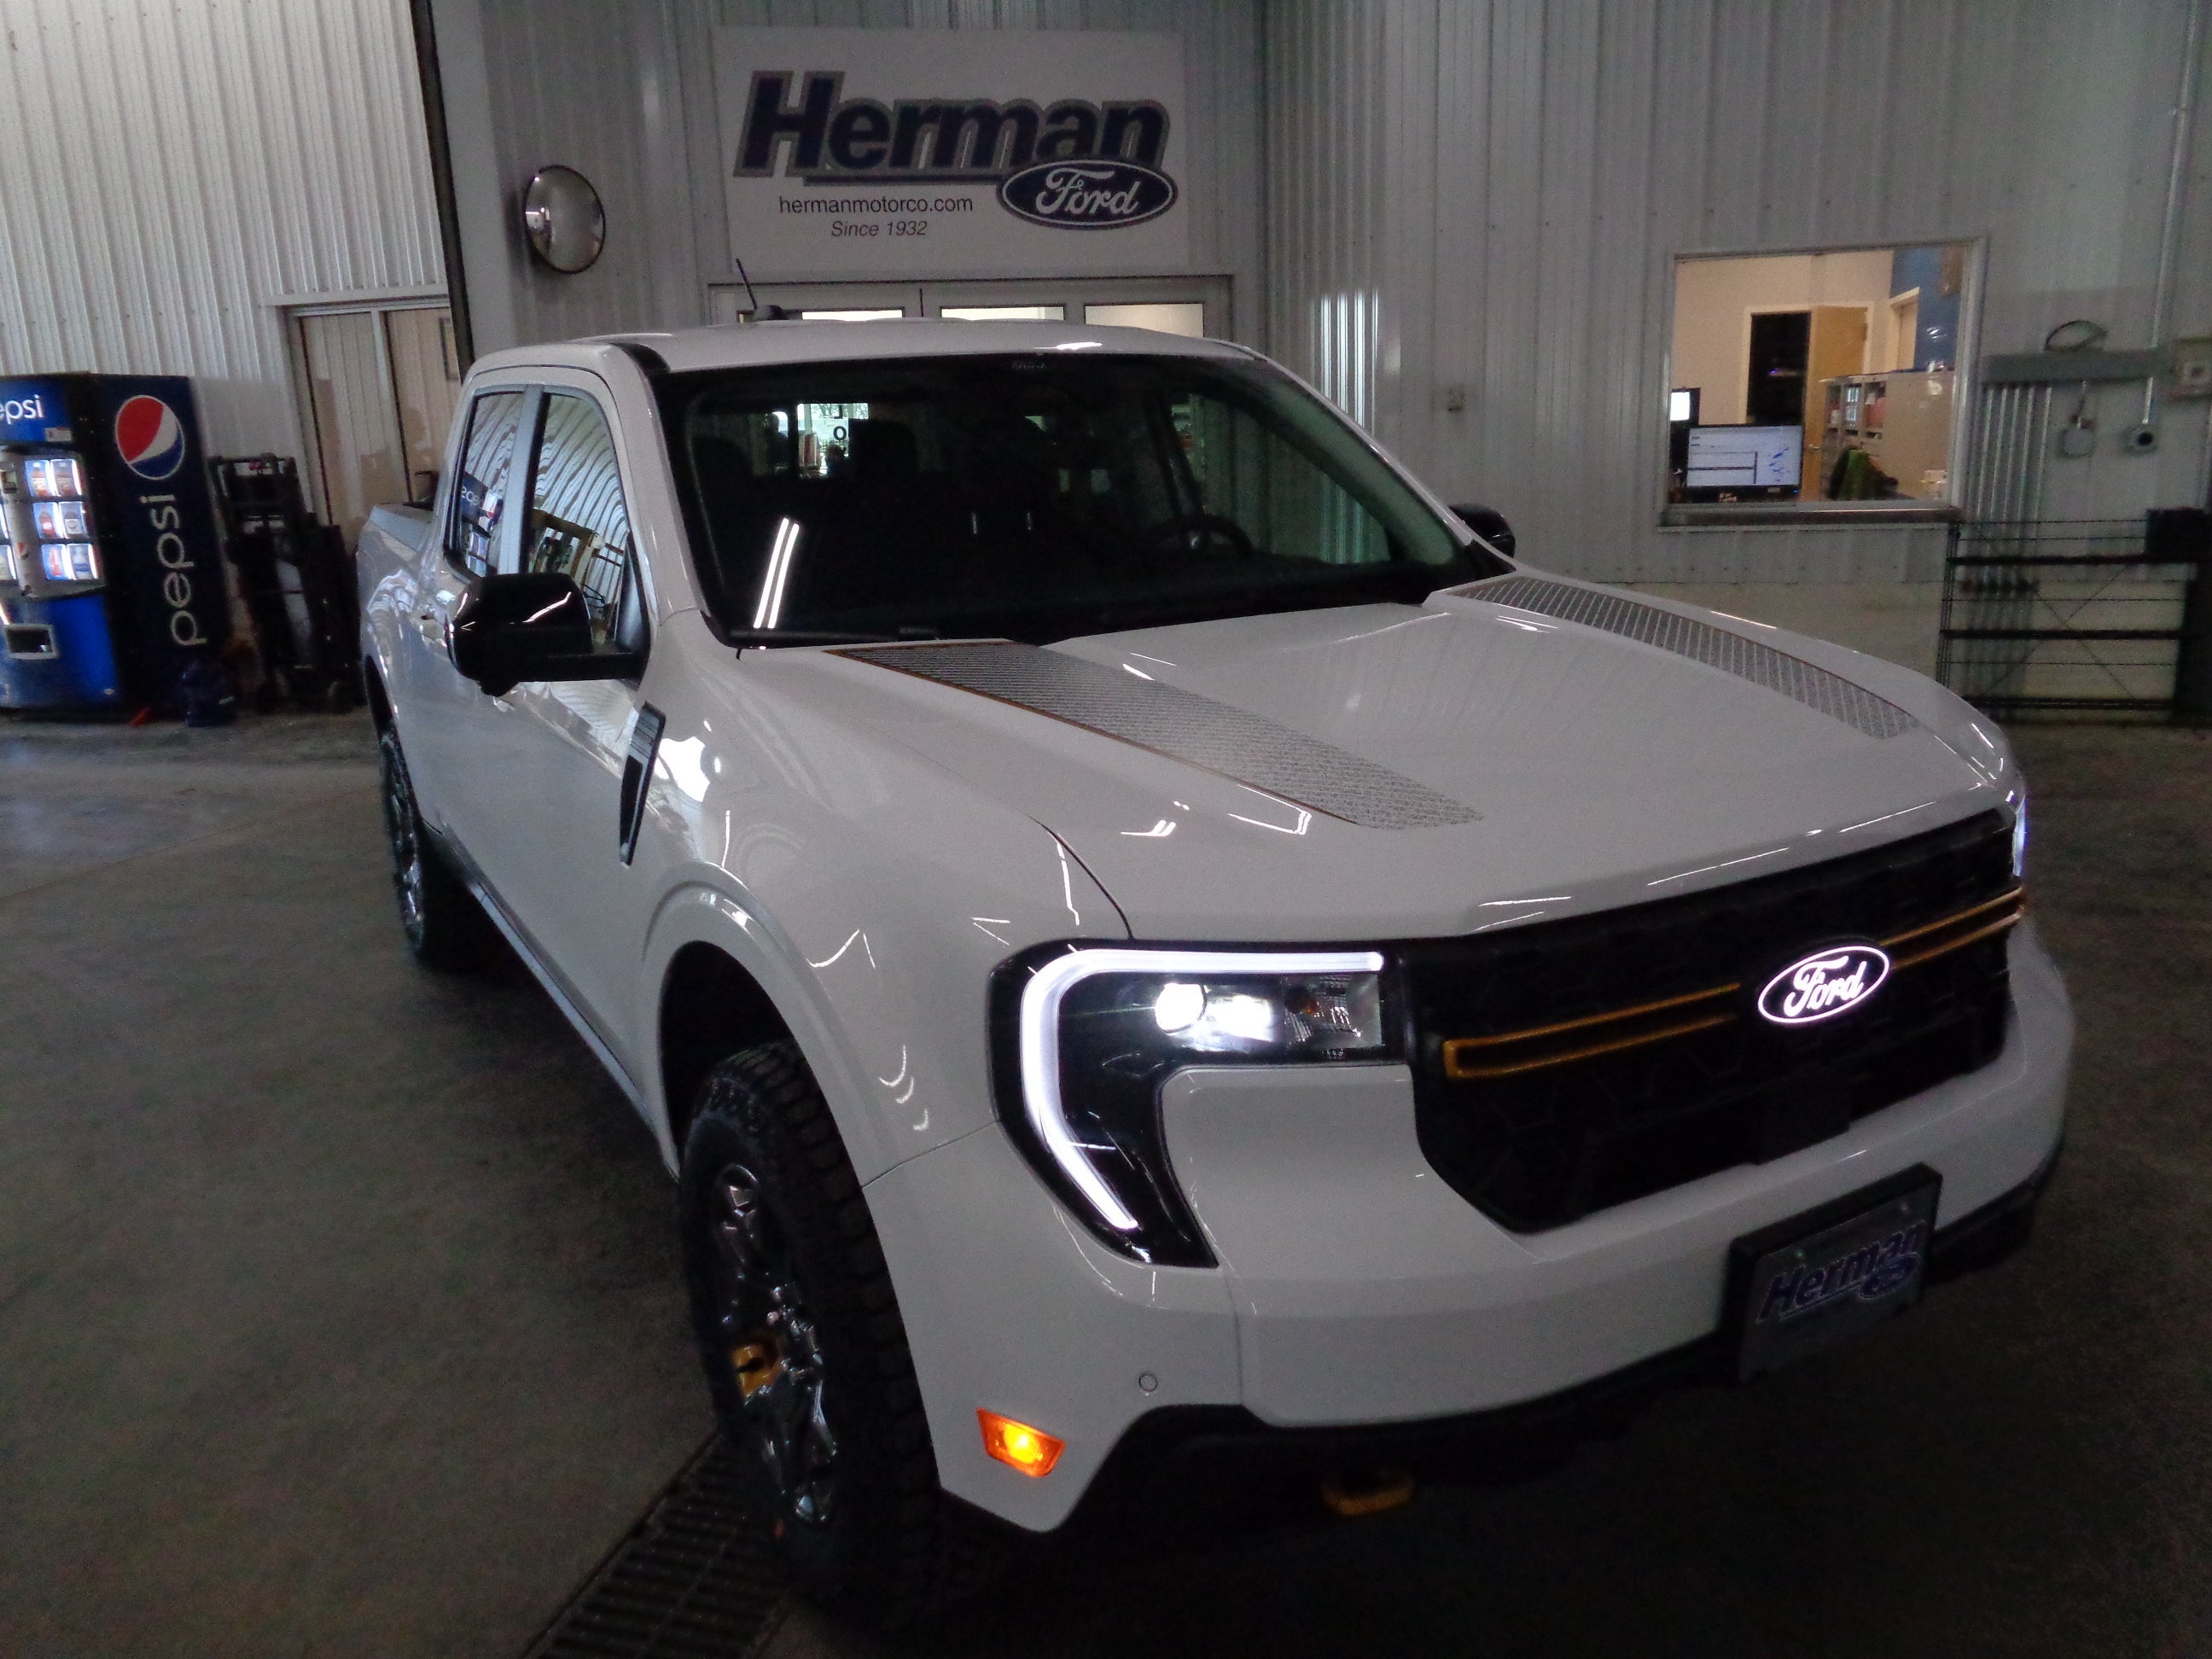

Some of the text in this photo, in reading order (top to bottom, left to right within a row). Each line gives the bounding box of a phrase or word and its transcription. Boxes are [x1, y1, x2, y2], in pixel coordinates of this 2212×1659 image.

[734, 70, 1170, 178] Herman
[778, 196, 973, 214] hermanmotorco.com
[1035, 167, 1140, 216] Ford
[830, 220, 928, 236] Since 1932
[139, 494, 208, 646] pepsi
[1784, 955, 1867, 1017] Ford
